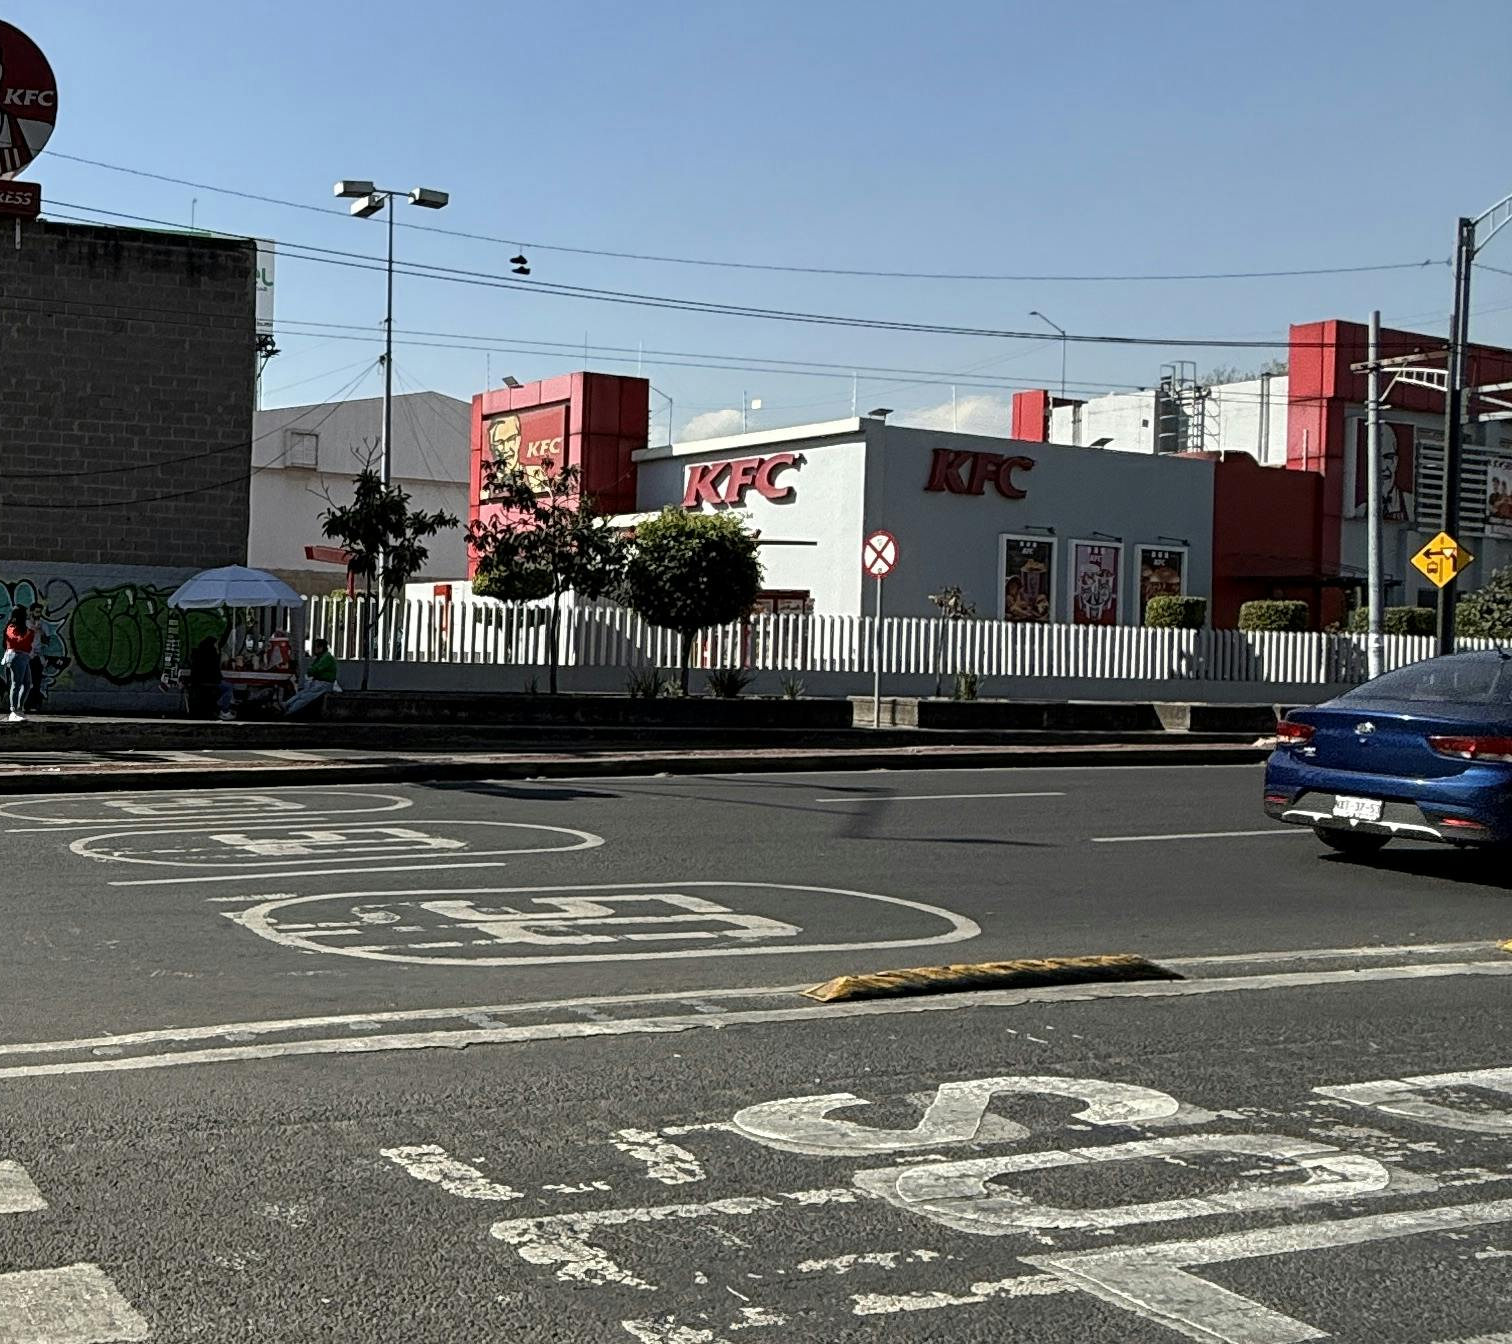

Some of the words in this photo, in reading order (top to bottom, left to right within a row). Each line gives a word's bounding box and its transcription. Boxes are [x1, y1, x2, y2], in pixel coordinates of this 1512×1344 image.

[2, 88, 54, 106] KFC
[526, 437, 563, 458] KFC
[682, 453, 796, 507] KFC
[924, 448, 1036, 500] KFC
[418, 892, 806, 946] 50
